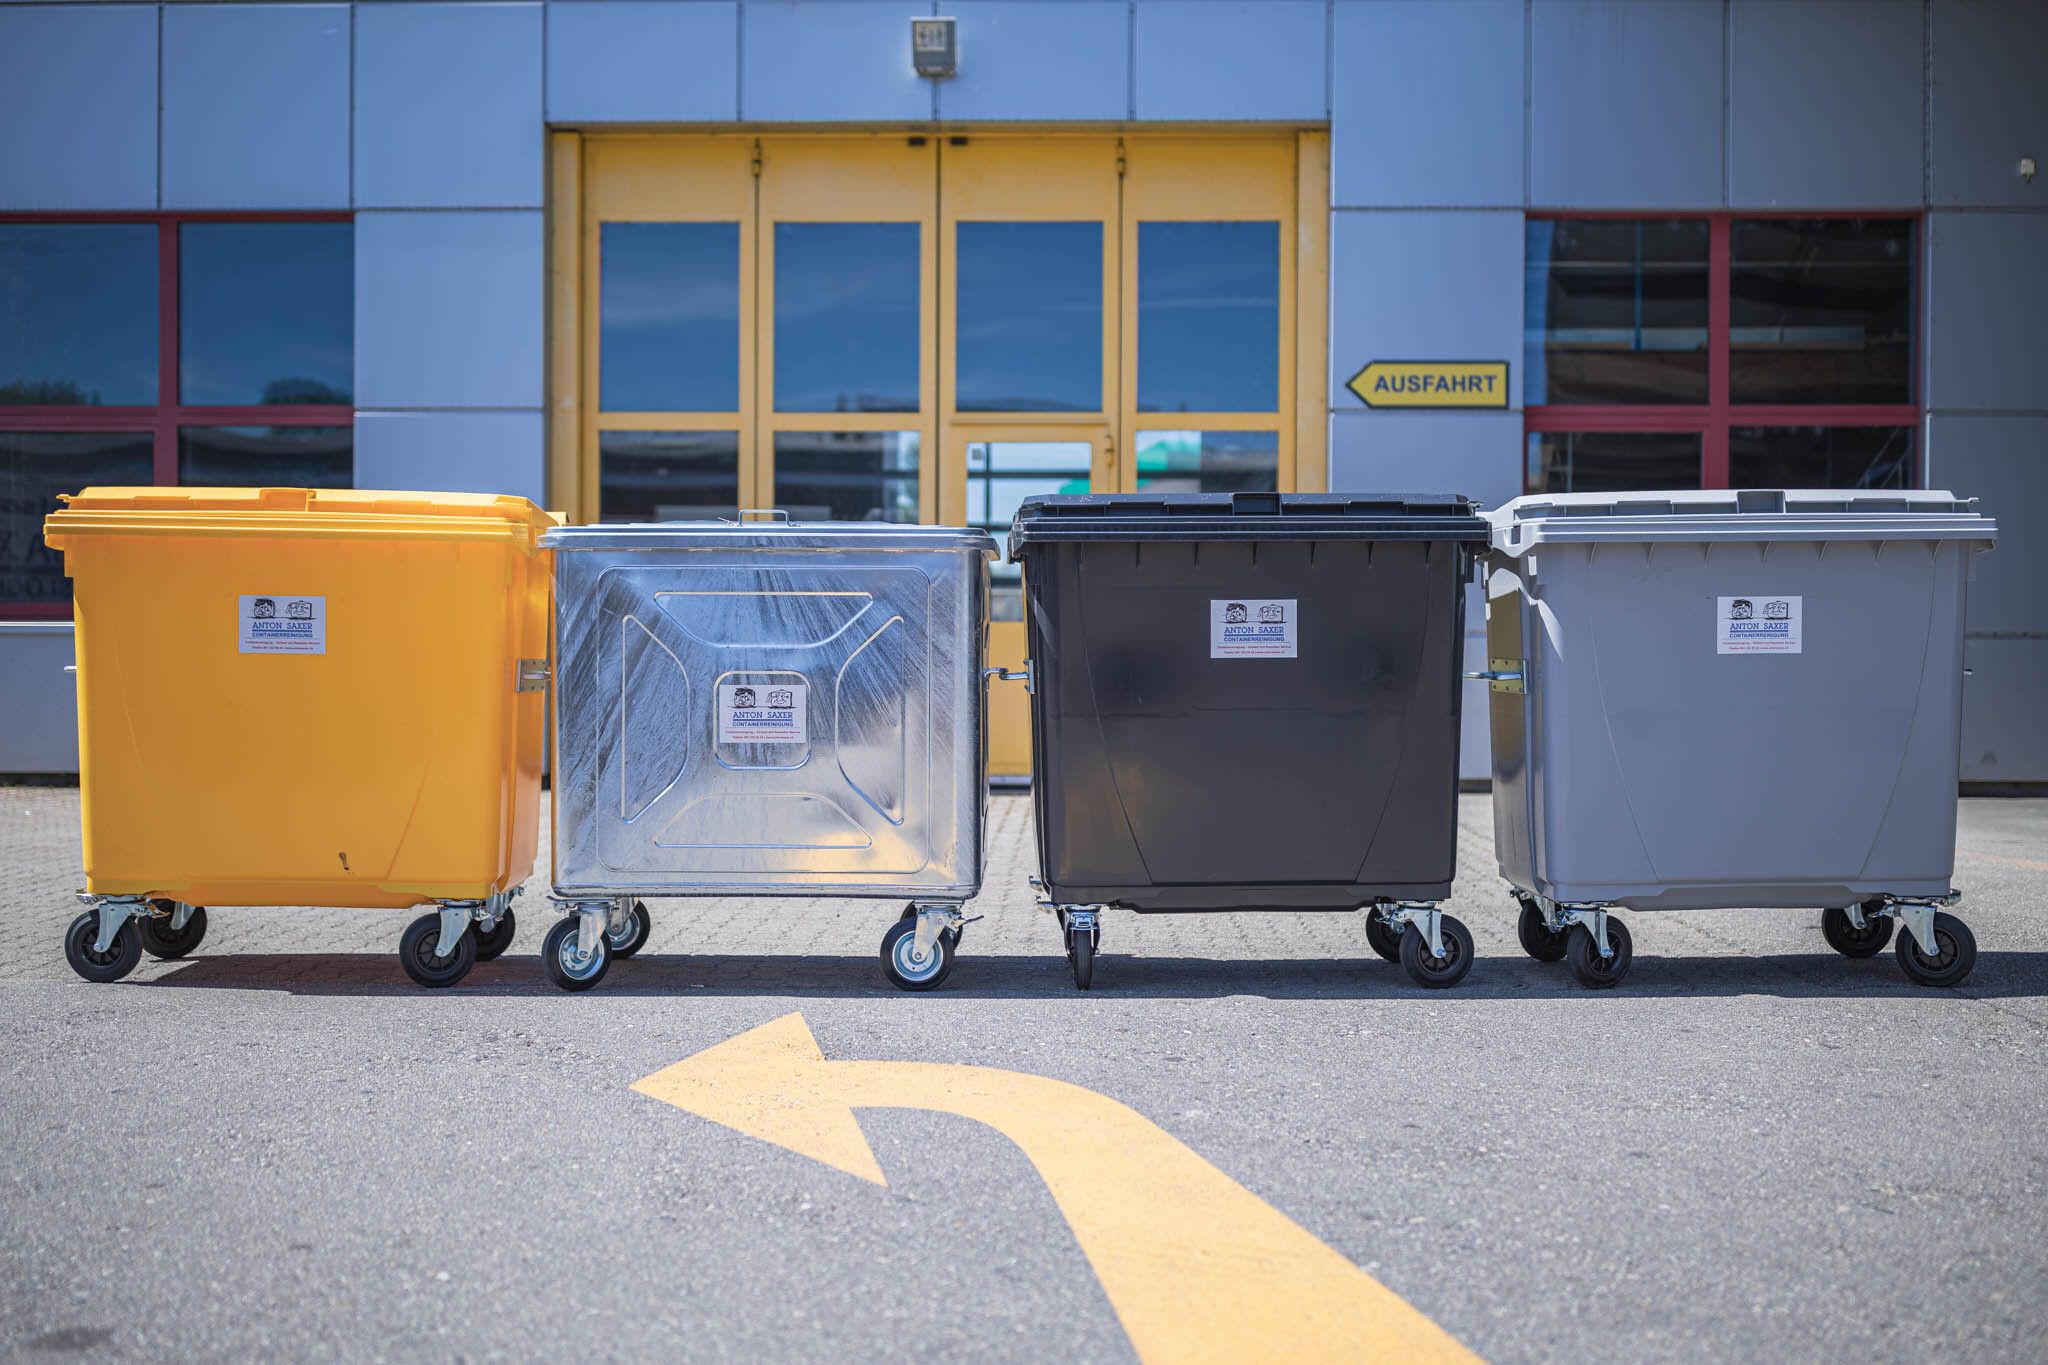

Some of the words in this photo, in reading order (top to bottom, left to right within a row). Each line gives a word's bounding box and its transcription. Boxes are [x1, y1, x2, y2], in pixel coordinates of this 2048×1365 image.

[1374, 375, 1497, 393] AUSFAHRT
[252, 621, 283, 630] ANTON
[286, 622, 313, 630] SAXER
[1729, 622, 1760, 630] ANTON
[1763, 622, 1789, 630] SAXER
[1223, 626, 1254, 634] ANTON
[1258, 626, 1285, 634] SAXER
[732, 711, 763, 719] ANTON
[767, 711, 793, 719] SAXER
